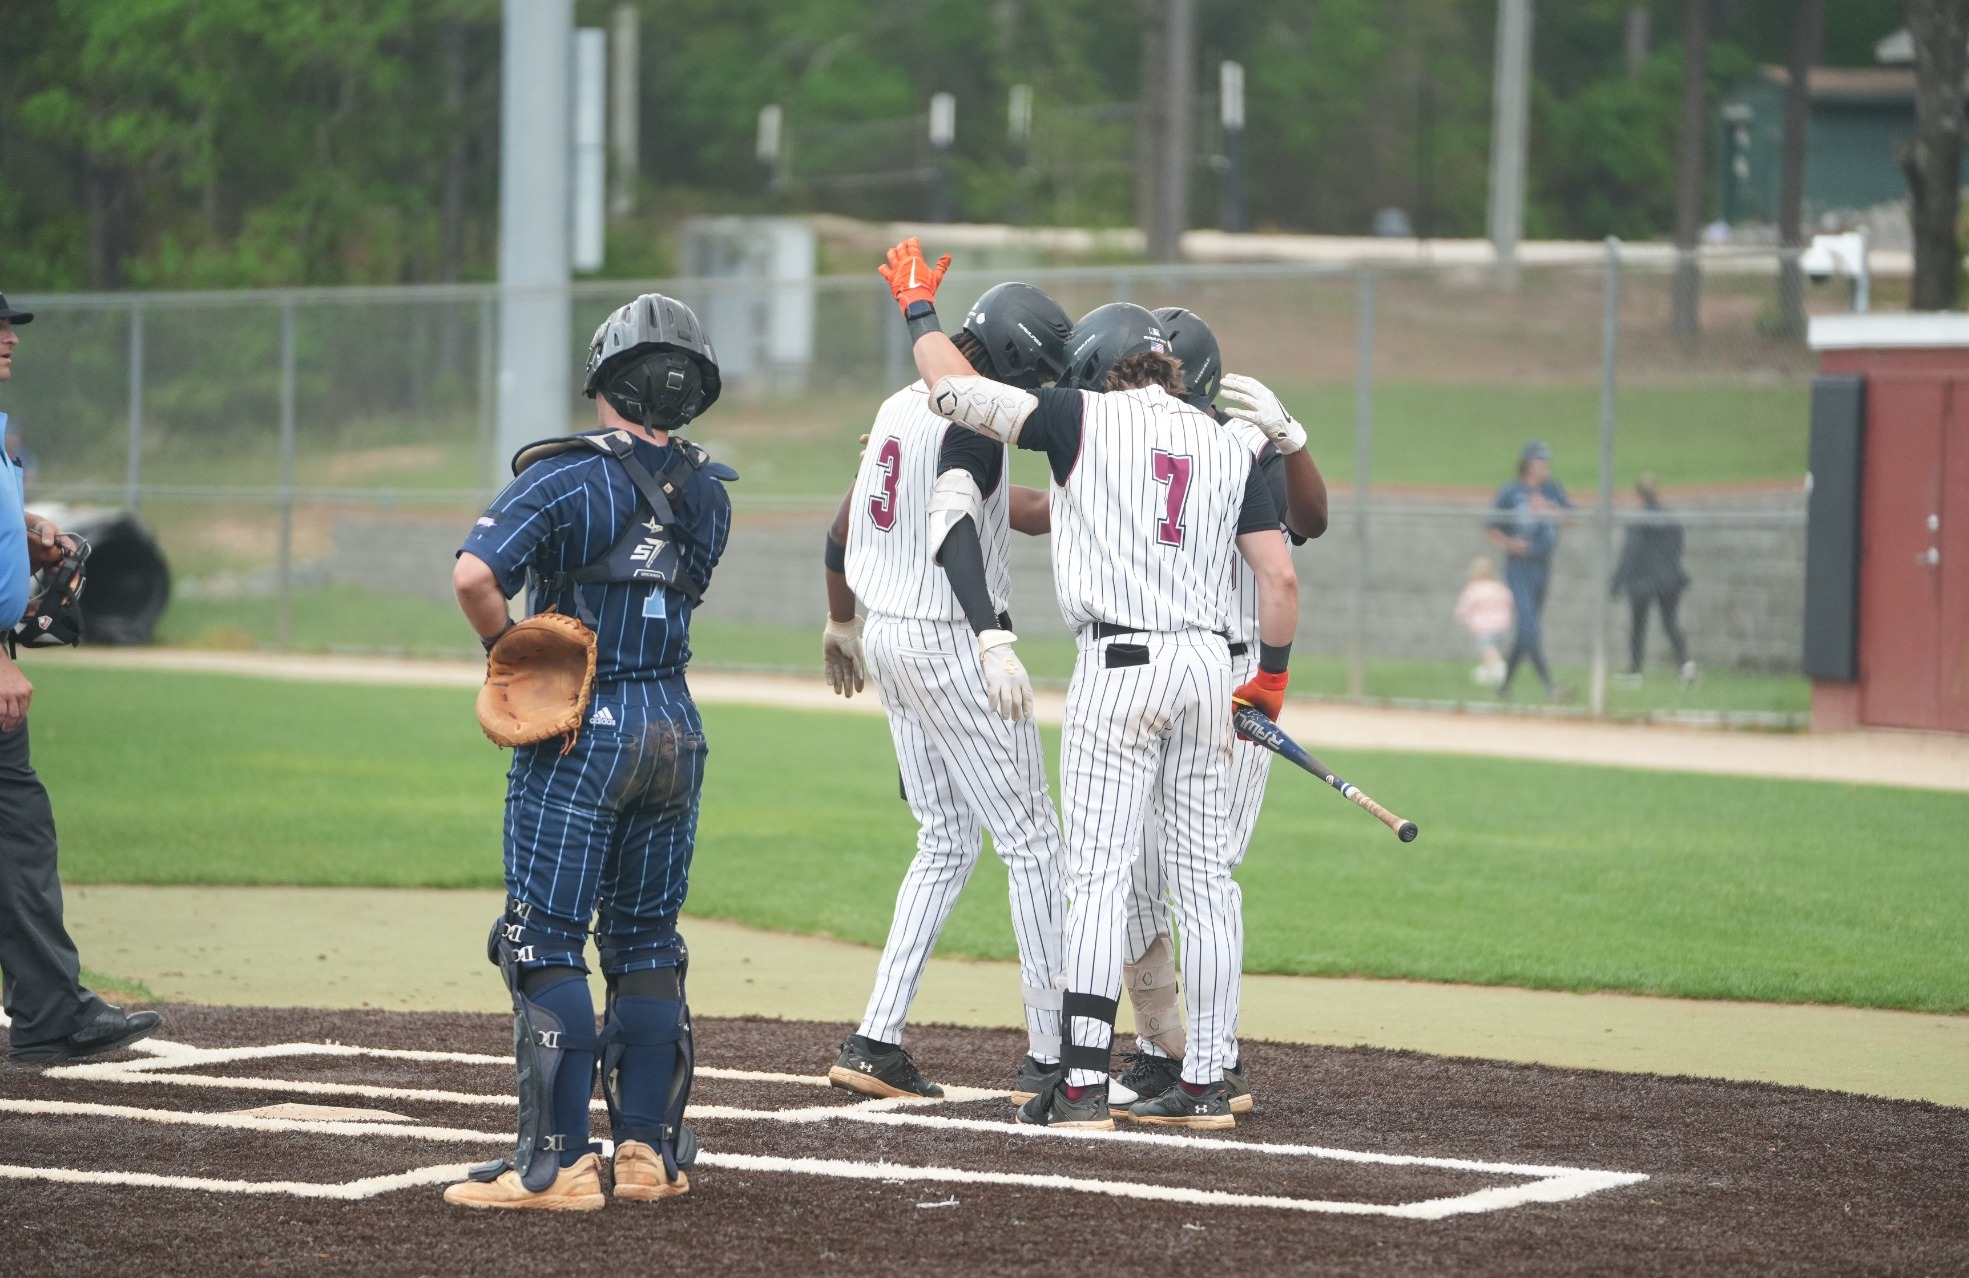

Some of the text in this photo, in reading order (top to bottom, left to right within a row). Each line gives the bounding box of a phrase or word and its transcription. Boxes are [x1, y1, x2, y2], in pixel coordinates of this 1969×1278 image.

[868, 435, 901, 532] 3
[1151, 448, 1193, 549] 7
[589, 717, 616, 726] adidas
